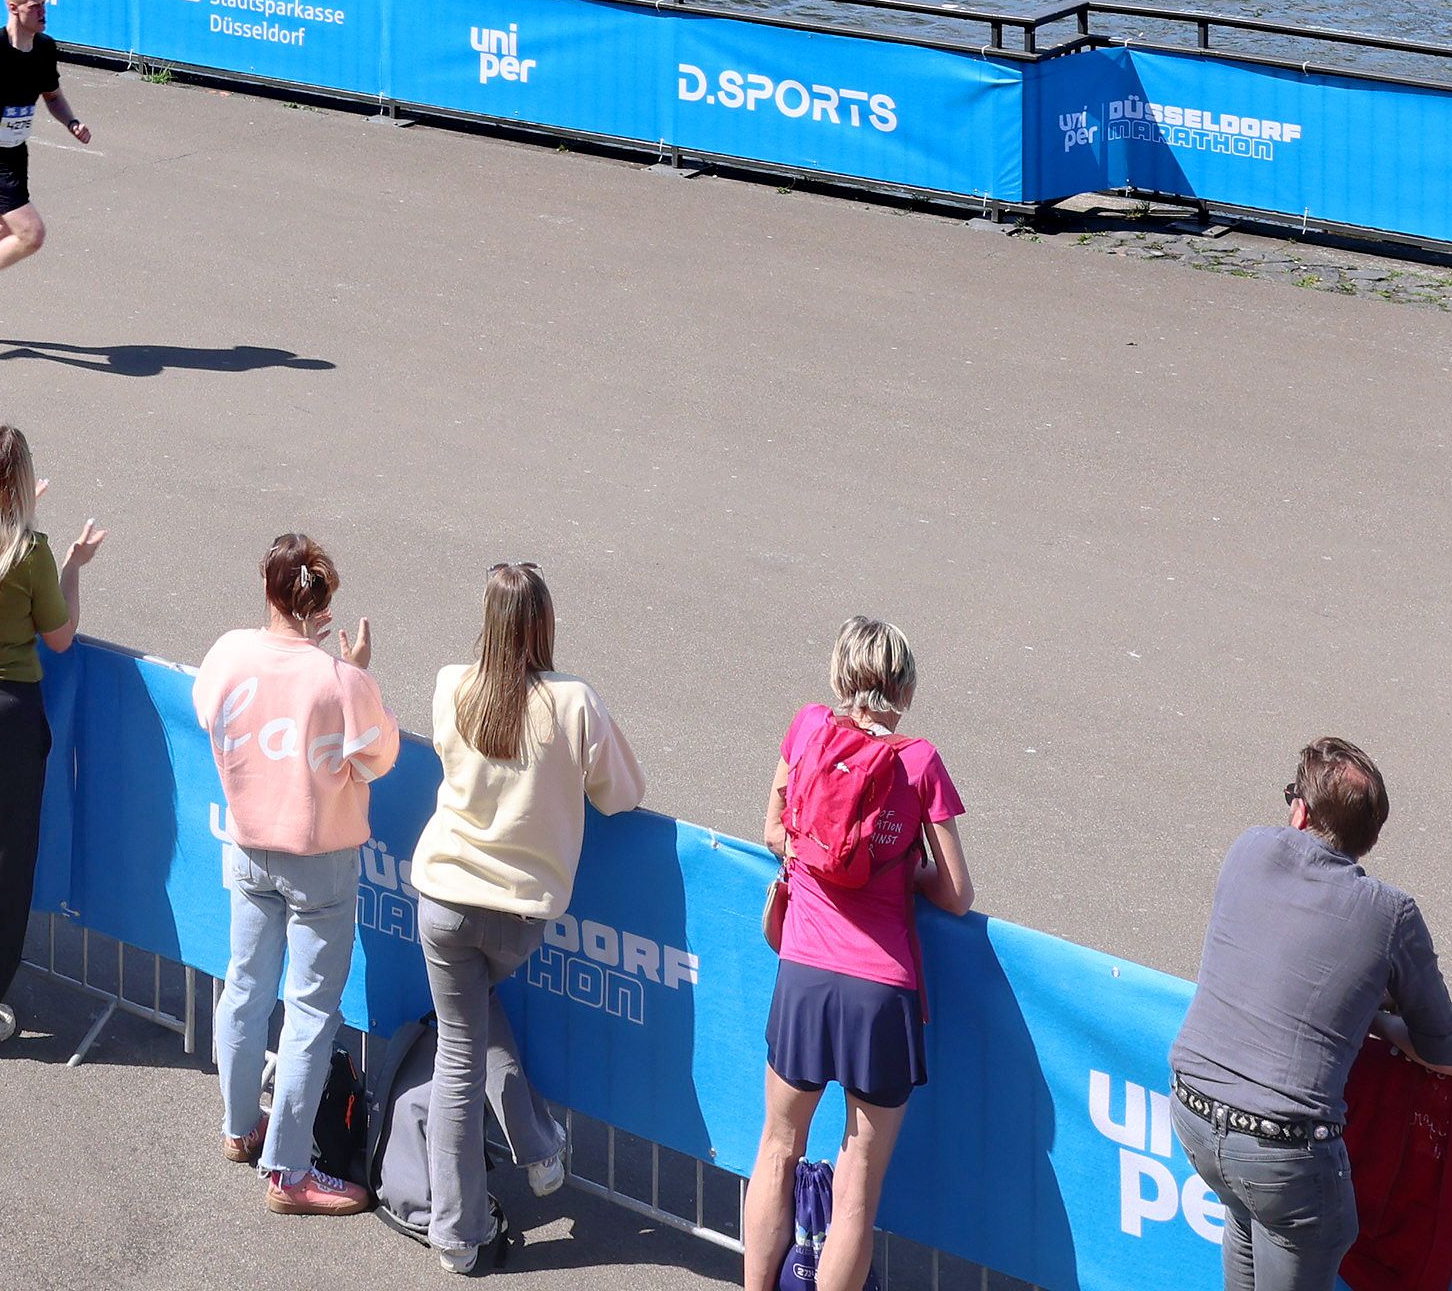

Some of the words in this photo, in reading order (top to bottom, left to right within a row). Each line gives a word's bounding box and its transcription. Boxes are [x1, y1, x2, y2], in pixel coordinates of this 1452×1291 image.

[210, 10, 310, 45] Düsseldorf
[470, 23, 519, 62] uni
[475, 48, 536, 84] per
[679, 64, 897, 132] D.SPORTS
[1060, 106, 1088, 132] uni
[1062, 125, 1097, 151] per
[1108, 101, 1302, 145] DÜSSELDORF
[1108, 118, 1276, 161] MARATHON
[1120, 1147, 1225, 1245] pe
